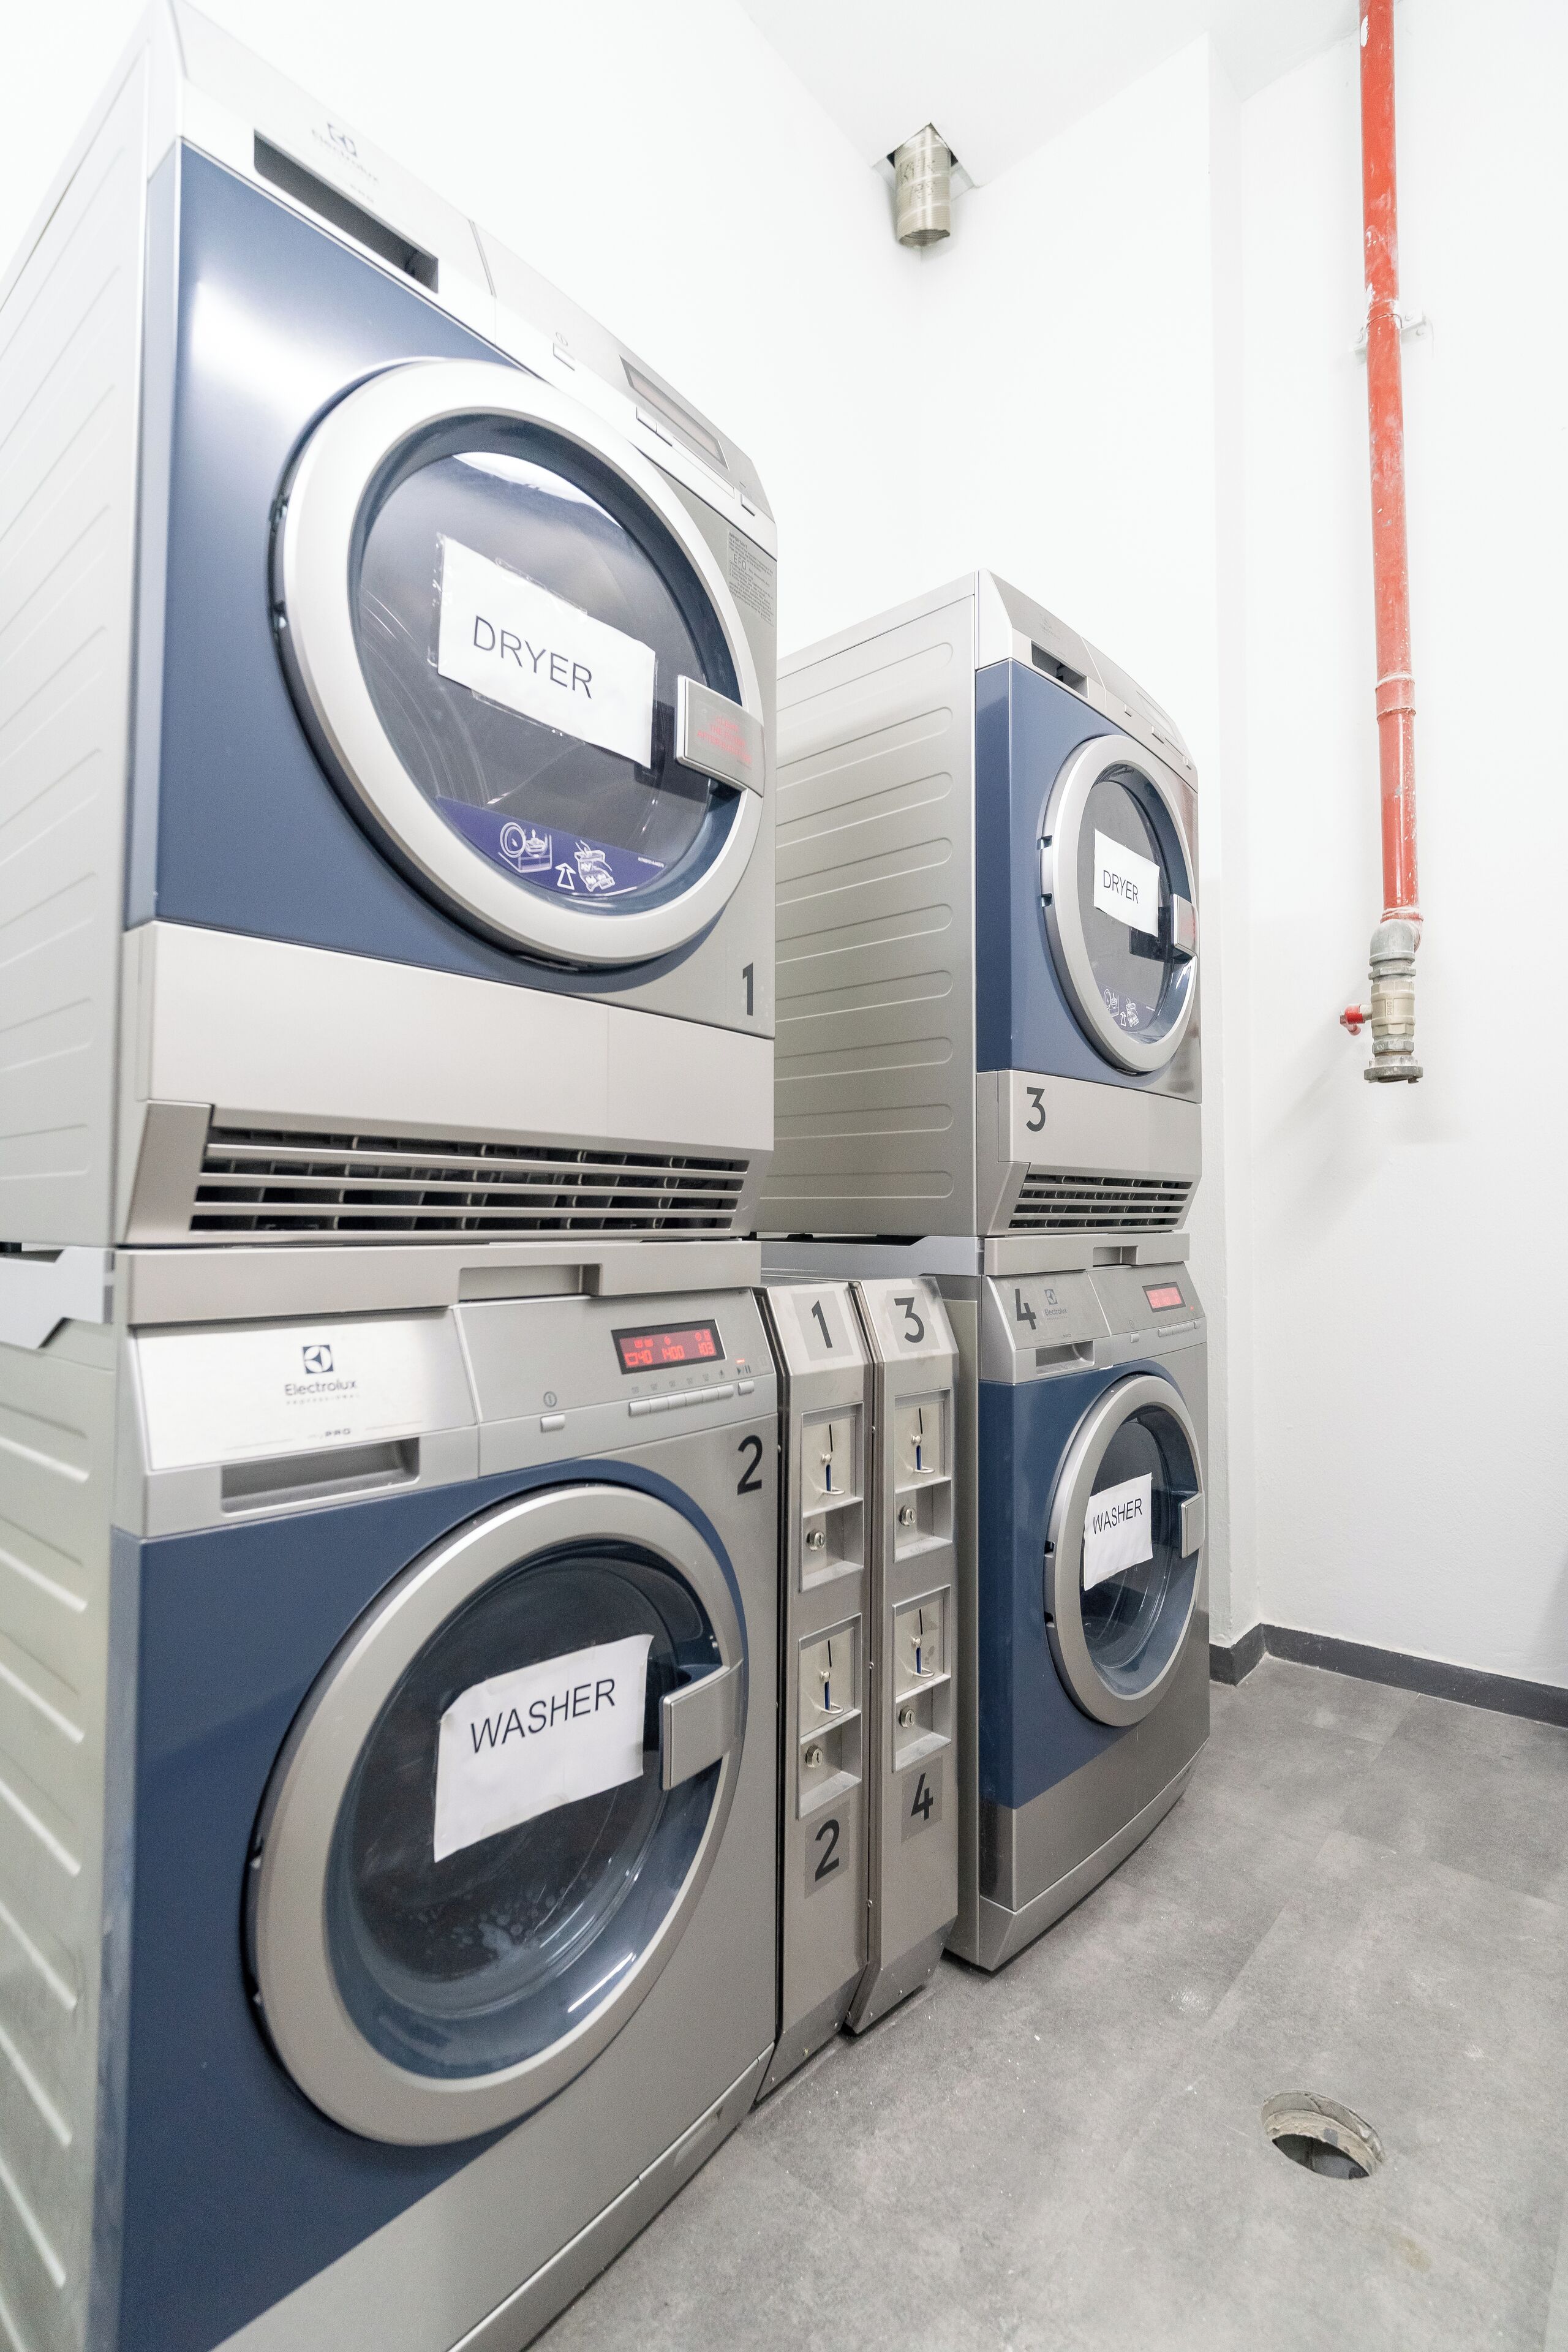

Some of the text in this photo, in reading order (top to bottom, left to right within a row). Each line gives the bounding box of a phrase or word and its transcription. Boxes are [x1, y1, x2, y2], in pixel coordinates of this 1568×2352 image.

[473, 615, 592, 699] DRYER
[1103, 869, 1139, 904] DRYER
[742, 962, 753, 1017] 1
[1026, 1086, 1046, 1133] 3
[810, 1299, 834, 1349] 1
[894, 1297, 925, 1343] 3
[1015, 1288, 1037, 1330] 4
[1044, 1308, 1068, 1316] Electrolux
[284, 1379, 357, 1396] Electrolux
[737, 1434, 763, 1496] 2
[1092, 1498, 1143, 1535] WASHER
[469, 1678, 616, 1754] WASHER
[910, 1771, 934, 1822] 4
[815, 1819, 840, 1883] 2
